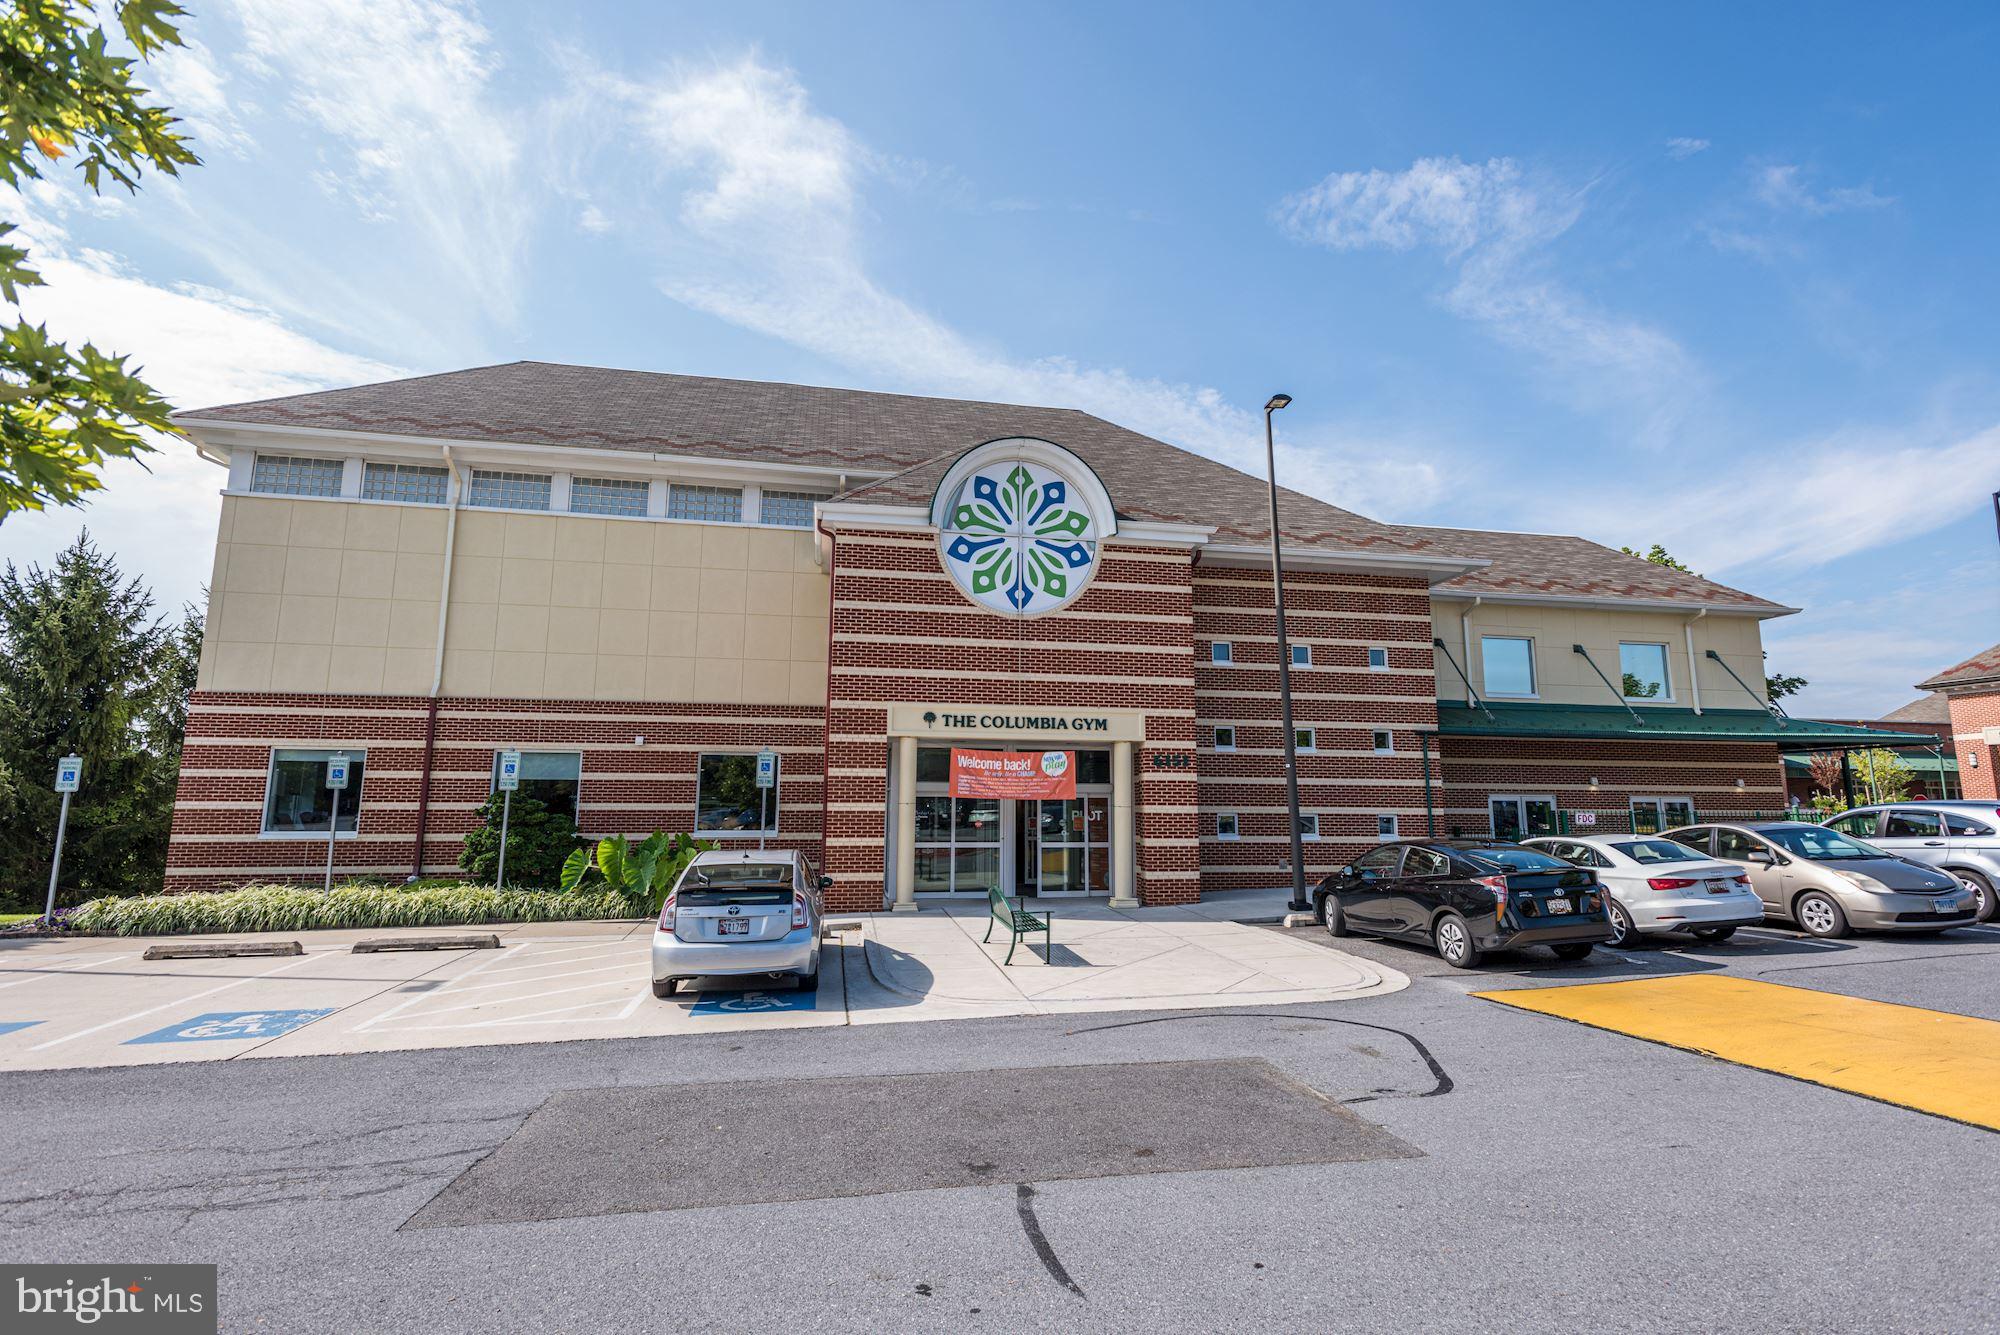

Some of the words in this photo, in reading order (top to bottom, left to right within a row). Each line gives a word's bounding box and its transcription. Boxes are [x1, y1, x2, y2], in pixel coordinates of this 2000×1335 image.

[942, 714, 977, 728] THE
[980, 715, 1068, 730] COLUMBIA
[1071, 718, 1108, 731] GYM
[957, 755, 1002, 770] Welcome
[1004, 758, 1031, 771] back!
[1577, 814, 1593, 823] FDC
